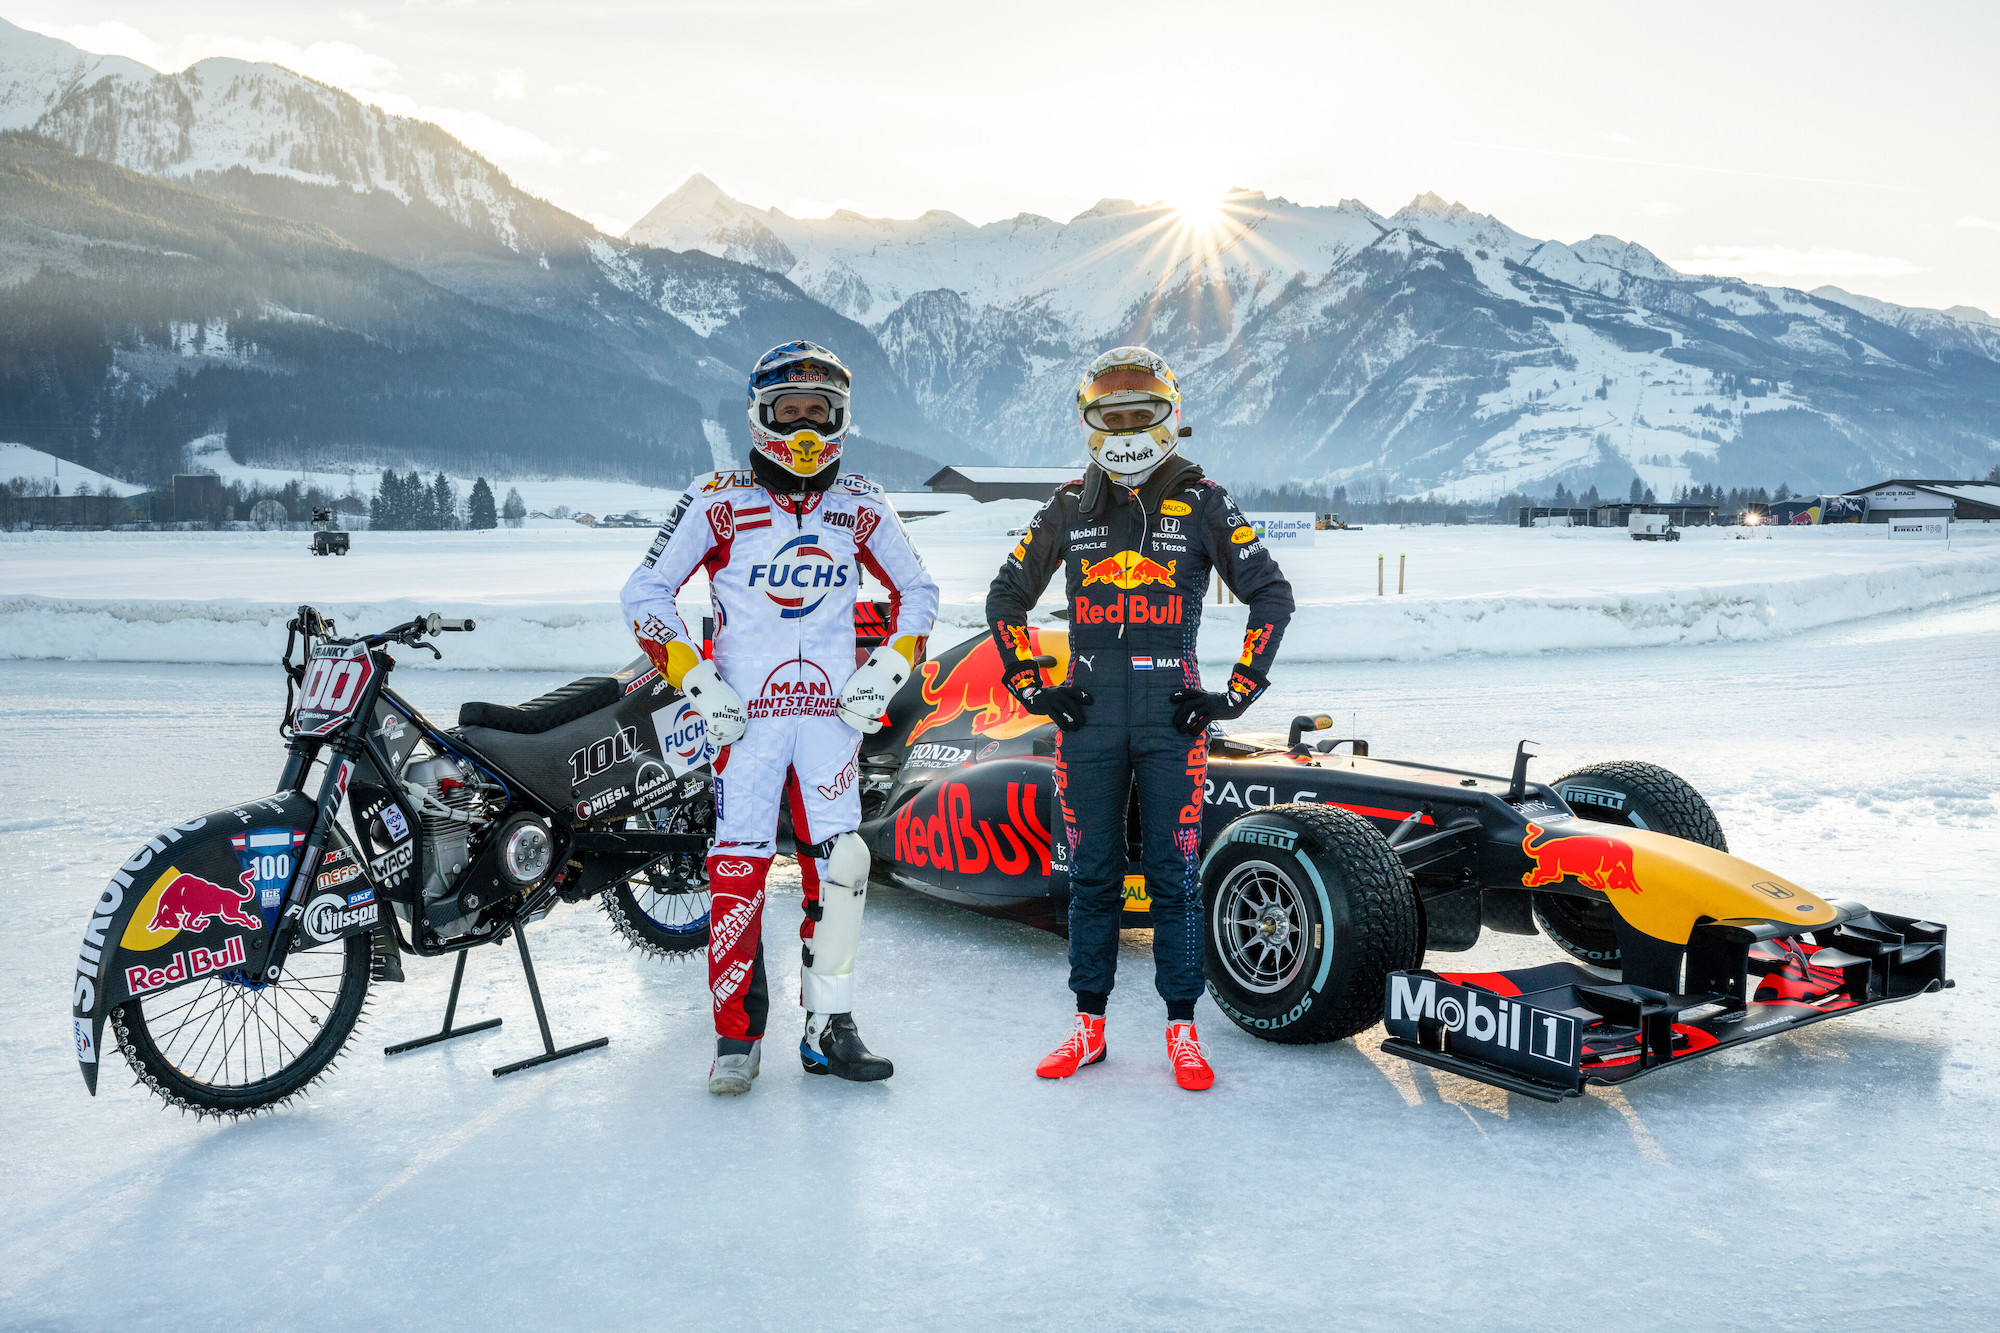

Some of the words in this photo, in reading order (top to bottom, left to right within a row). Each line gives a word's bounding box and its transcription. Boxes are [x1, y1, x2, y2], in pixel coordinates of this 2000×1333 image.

[789, 372, 807, 381] Red
[808, 373, 824, 382] Bull
[1130, 365, 1151, 374] WINGS
[1105, 448, 1154, 463] CarNext
[836, 478, 880, 494] FUCHS
[1162, 504, 1187, 513] RAUCH
[823, 510, 856, 528] #100
[1268, 521, 1283, 530] Zell
[1296, 521, 1311, 530] See
[1070, 528, 1097, 541] Mobil
[1152, 532, 1187, 540] HONDA
[1268, 530, 1297, 540] Kaprun
[1070, 541, 1107, 551] ORACLE
[1161, 542, 1187, 552] Tezos
[748, 563, 849, 588] FUCHS
[1075, 593, 1125, 624] Red
[1128, 595, 1183, 625] Bull
[314, 646, 349, 658] FRANKY
[1157, 659, 1181, 668] MAX
[771, 682, 826, 697] MAN
[747, 709, 768, 719] BAD
[772, 707, 839, 718] REICHENHA
[568, 725, 637, 786] 100
[908, 743, 972, 762] HONDA
[638, 774, 666, 795] MAN
[592, 786, 630, 812] MIESL
[632, 779, 678, 808] HINTSTEINER
[1560, 784, 1627, 811] PIRELLI
[386, 812, 402, 827] FUCHS
[895, 781, 954, 872] Red
[948, 782, 1051, 876] Bull
[1231, 823, 1298, 850] PIRELLI
[249, 853, 290, 881] 100
[372, 845, 413, 878] WACO
[1050, 860, 1069, 872] Tezo
[261, 889, 280, 898] ICE
[350, 890, 372, 903] SKF
[321, 904, 378, 934] Nilsson
[711, 889, 764, 956] HINTSTEINER
[714, 902, 747, 938] MAN
[129, 955, 185, 993] Red
[190, 936, 244, 974] Bull
[714, 949, 726, 964] BAD
[1206, 979, 1312, 1030] SOTTOZERO
[1391, 975, 1521, 1052] Mobil
